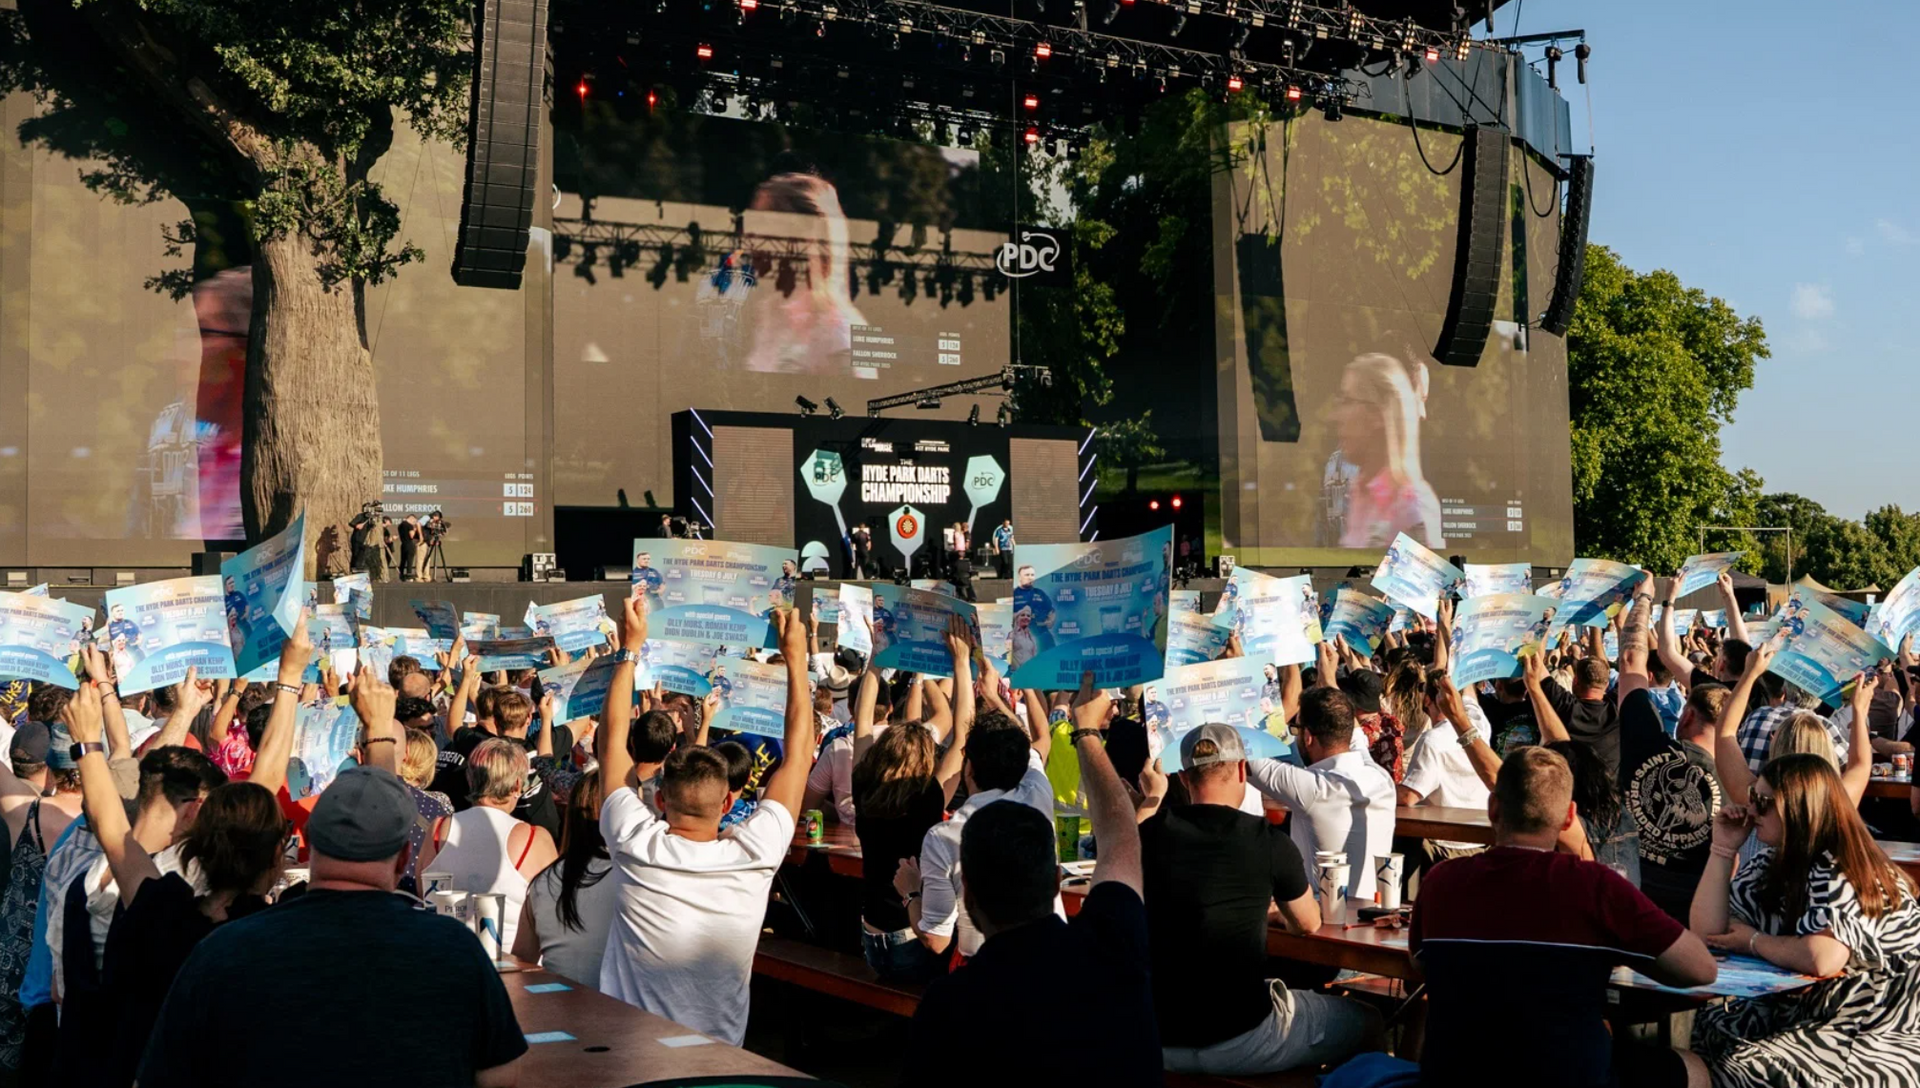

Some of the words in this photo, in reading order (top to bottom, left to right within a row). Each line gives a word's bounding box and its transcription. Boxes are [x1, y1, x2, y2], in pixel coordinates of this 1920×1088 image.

[1000, 240, 1057, 274] PDC
[852, 335, 865, 343] LUKE
[865, 336, 895, 345] HUMPHRIES
[852, 350, 871, 358] FALLON
[871, 351, 897, 360] SHERROCK
[862, 464, 888, 482] HYDE
[889, 465, 917, 483] PARK
[917, 466, 950, 484] DARTS
[974, 476, 994, 487] PDC
[382, 484, 395, 493] UKE
[396, 484, 438, 494] HUMPHRIES
[508, 485, 513, 494] 5
[519, 485, 532, 494] 124
[861, 482, 951, 504] CHAMPIONSHIP
[382, 504, 403, 513] ALLON
[405, 504, 442, 513] SHERROCK
[508, 504, 513, 513] 5
[684, 545, 706, 556] PDC
[1077, 554, 1101, 564] PDC
[674, 559, 688, 567] HYDE
[706, 560, 724, 569] DARTS
[725, 562, 768, 573] CHAMPIONSHIP
[690, 569, 716, 579] TUESDAY
[722, 571, 738, 580] JULY
[1051, 573, 1064, 583] THE
[1065, 572, 1082, 582] HYDE
[1084, 571, 1100, 582] PARK
[1102, 569, 1121, 580] DARTS
[1085, 585, 1113, 597] TUESDAY
[135, 604, 145, 613] THE
[145, 602, 159, 612] HYDE
[160, 600, 174, 608] PARK
[175, 597, 193, 607] DARTS
[685, 611, 696, 619] with
[667, 618, 682, 627] OLLY
[704, 621, 727, 632] ROMAN
[729, 624, 747, 632] KEMP
[664, 627, 680, 637] DION
[681, 628, 705, 638] DUBLIN
[706, 631, 711, 639] &
[712, 632, 724, 641] JOE
[725, 632, 748, 642] SWASH
[1081, 646, 1095, 656] with
[151, 663, 165, 674] OLLY
[207, 655, 225, 666] KEMP
[1060, 660, 1079, 671] OLLY
[150, 673, 165, 684] DION
[206, 665, 227, 675] SWASH
[1057, 672, 1077, 684] DION
[1166, 688, 1175, 696] THE
[1175, 686, 1187, 694] HYDE
[1188, 684, 1200, 692] PARK
[1201, 681, 1217, 690] DARTS
[1217, 676, 1253, 688] CHAMPIONSHIP
[1635, 753, 1671, 778] SAINT
[1630, 780, 1661, 837] BRANDED
